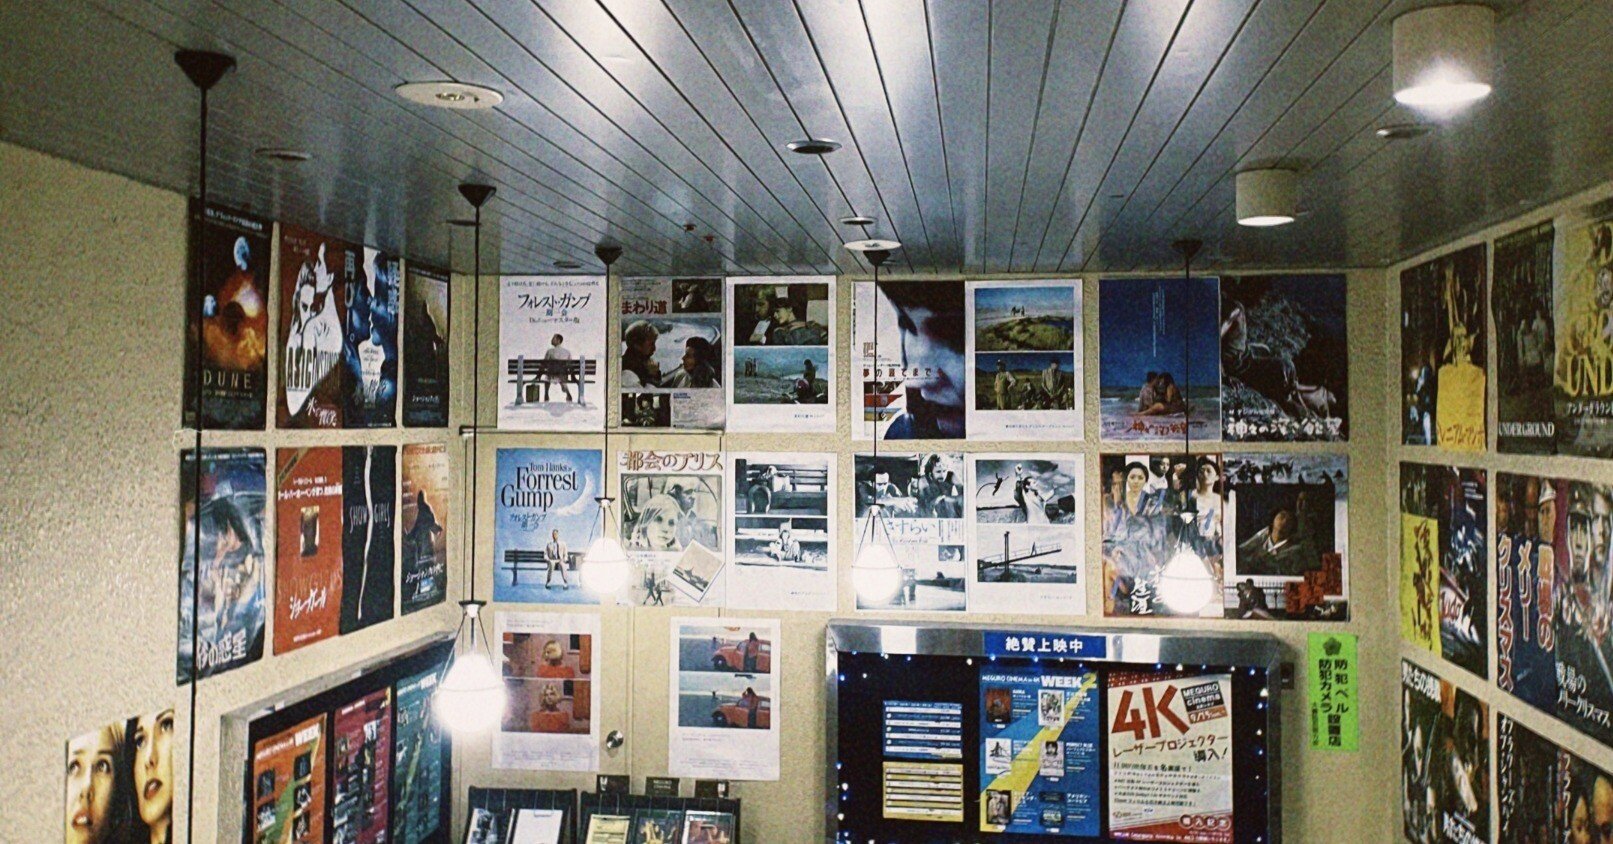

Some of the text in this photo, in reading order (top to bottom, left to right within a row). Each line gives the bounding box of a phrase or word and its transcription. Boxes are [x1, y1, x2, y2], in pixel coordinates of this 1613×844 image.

[517, 293, 592, 309] フォレスト・ガンプ
[621, 300, 667, 316] まわり道
[285, 346, 315, 389] ASIC
[203, 369, 252, 389] DUNE
[1498, 421, 1555, 438] UNDERGROUND
[530, 463, 544, 472] Tom
[620, 450, 723, 472] 都会のアリス
[516, 467, 578, 491] Forrest
[501, 484, 553, 512] Gump
[349, 500, 391, 533] SHOW GIRLS
[1498, 533, 1513, 694] クリスマス
[1005, 636, 1083, 654] 絶賛上映中
[1041, 675, 1083, 688] WEEK
[1083, 672, 1098, 688] 2
[1183, 683, 1220, 698] MEGURO
[1319, 659, 1333, 713] 防犯カメラ
[1334, 659, 1349, 713] 防犯ベル
[1186, 694, 1221, 706] cinema
[1111, 684, 1190, 741] 4K
[1113, 734, 1228, 758] レーザープロジェクター
